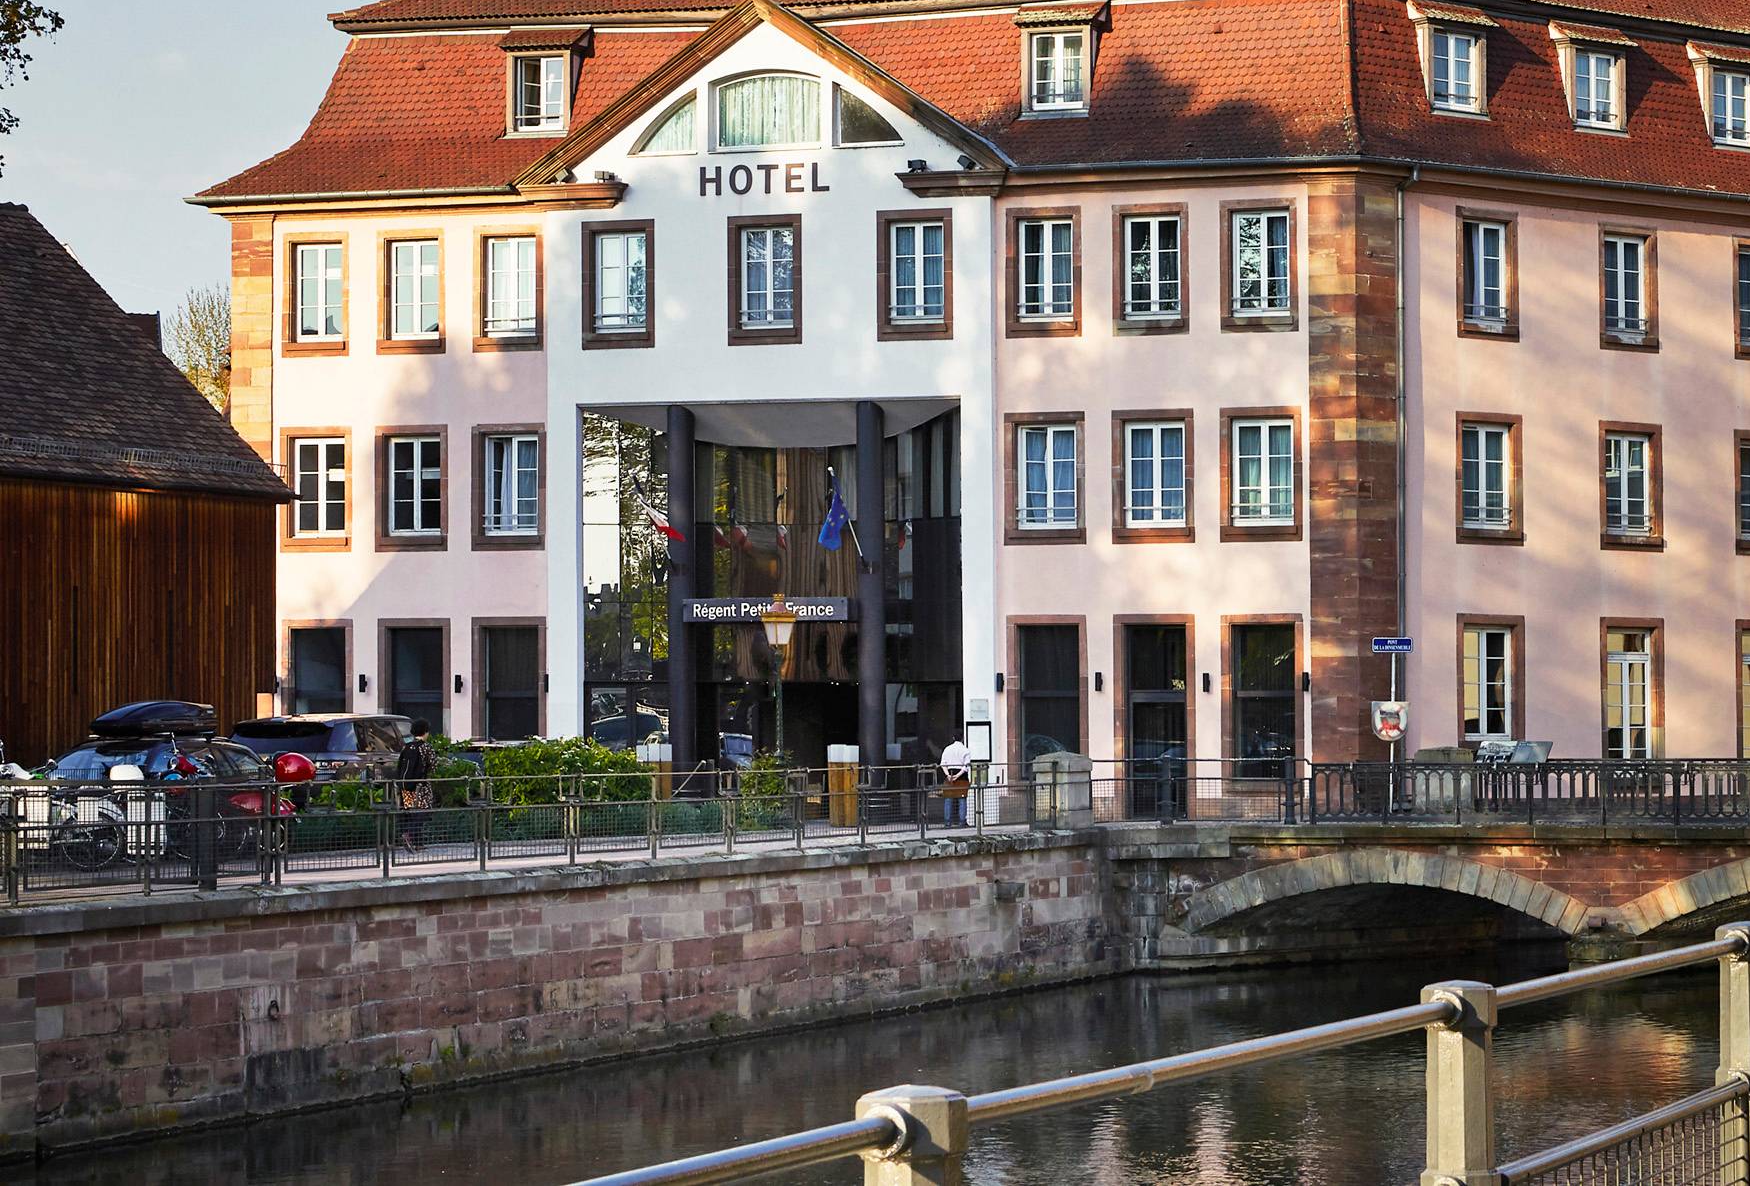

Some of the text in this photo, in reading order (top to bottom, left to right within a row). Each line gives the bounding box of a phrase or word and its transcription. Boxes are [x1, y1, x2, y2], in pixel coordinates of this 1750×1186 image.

[699, 162, 830, 197] HOTEL
[693, 603, 737, 620] Régent
[740, 602, 771, 617] Petit
